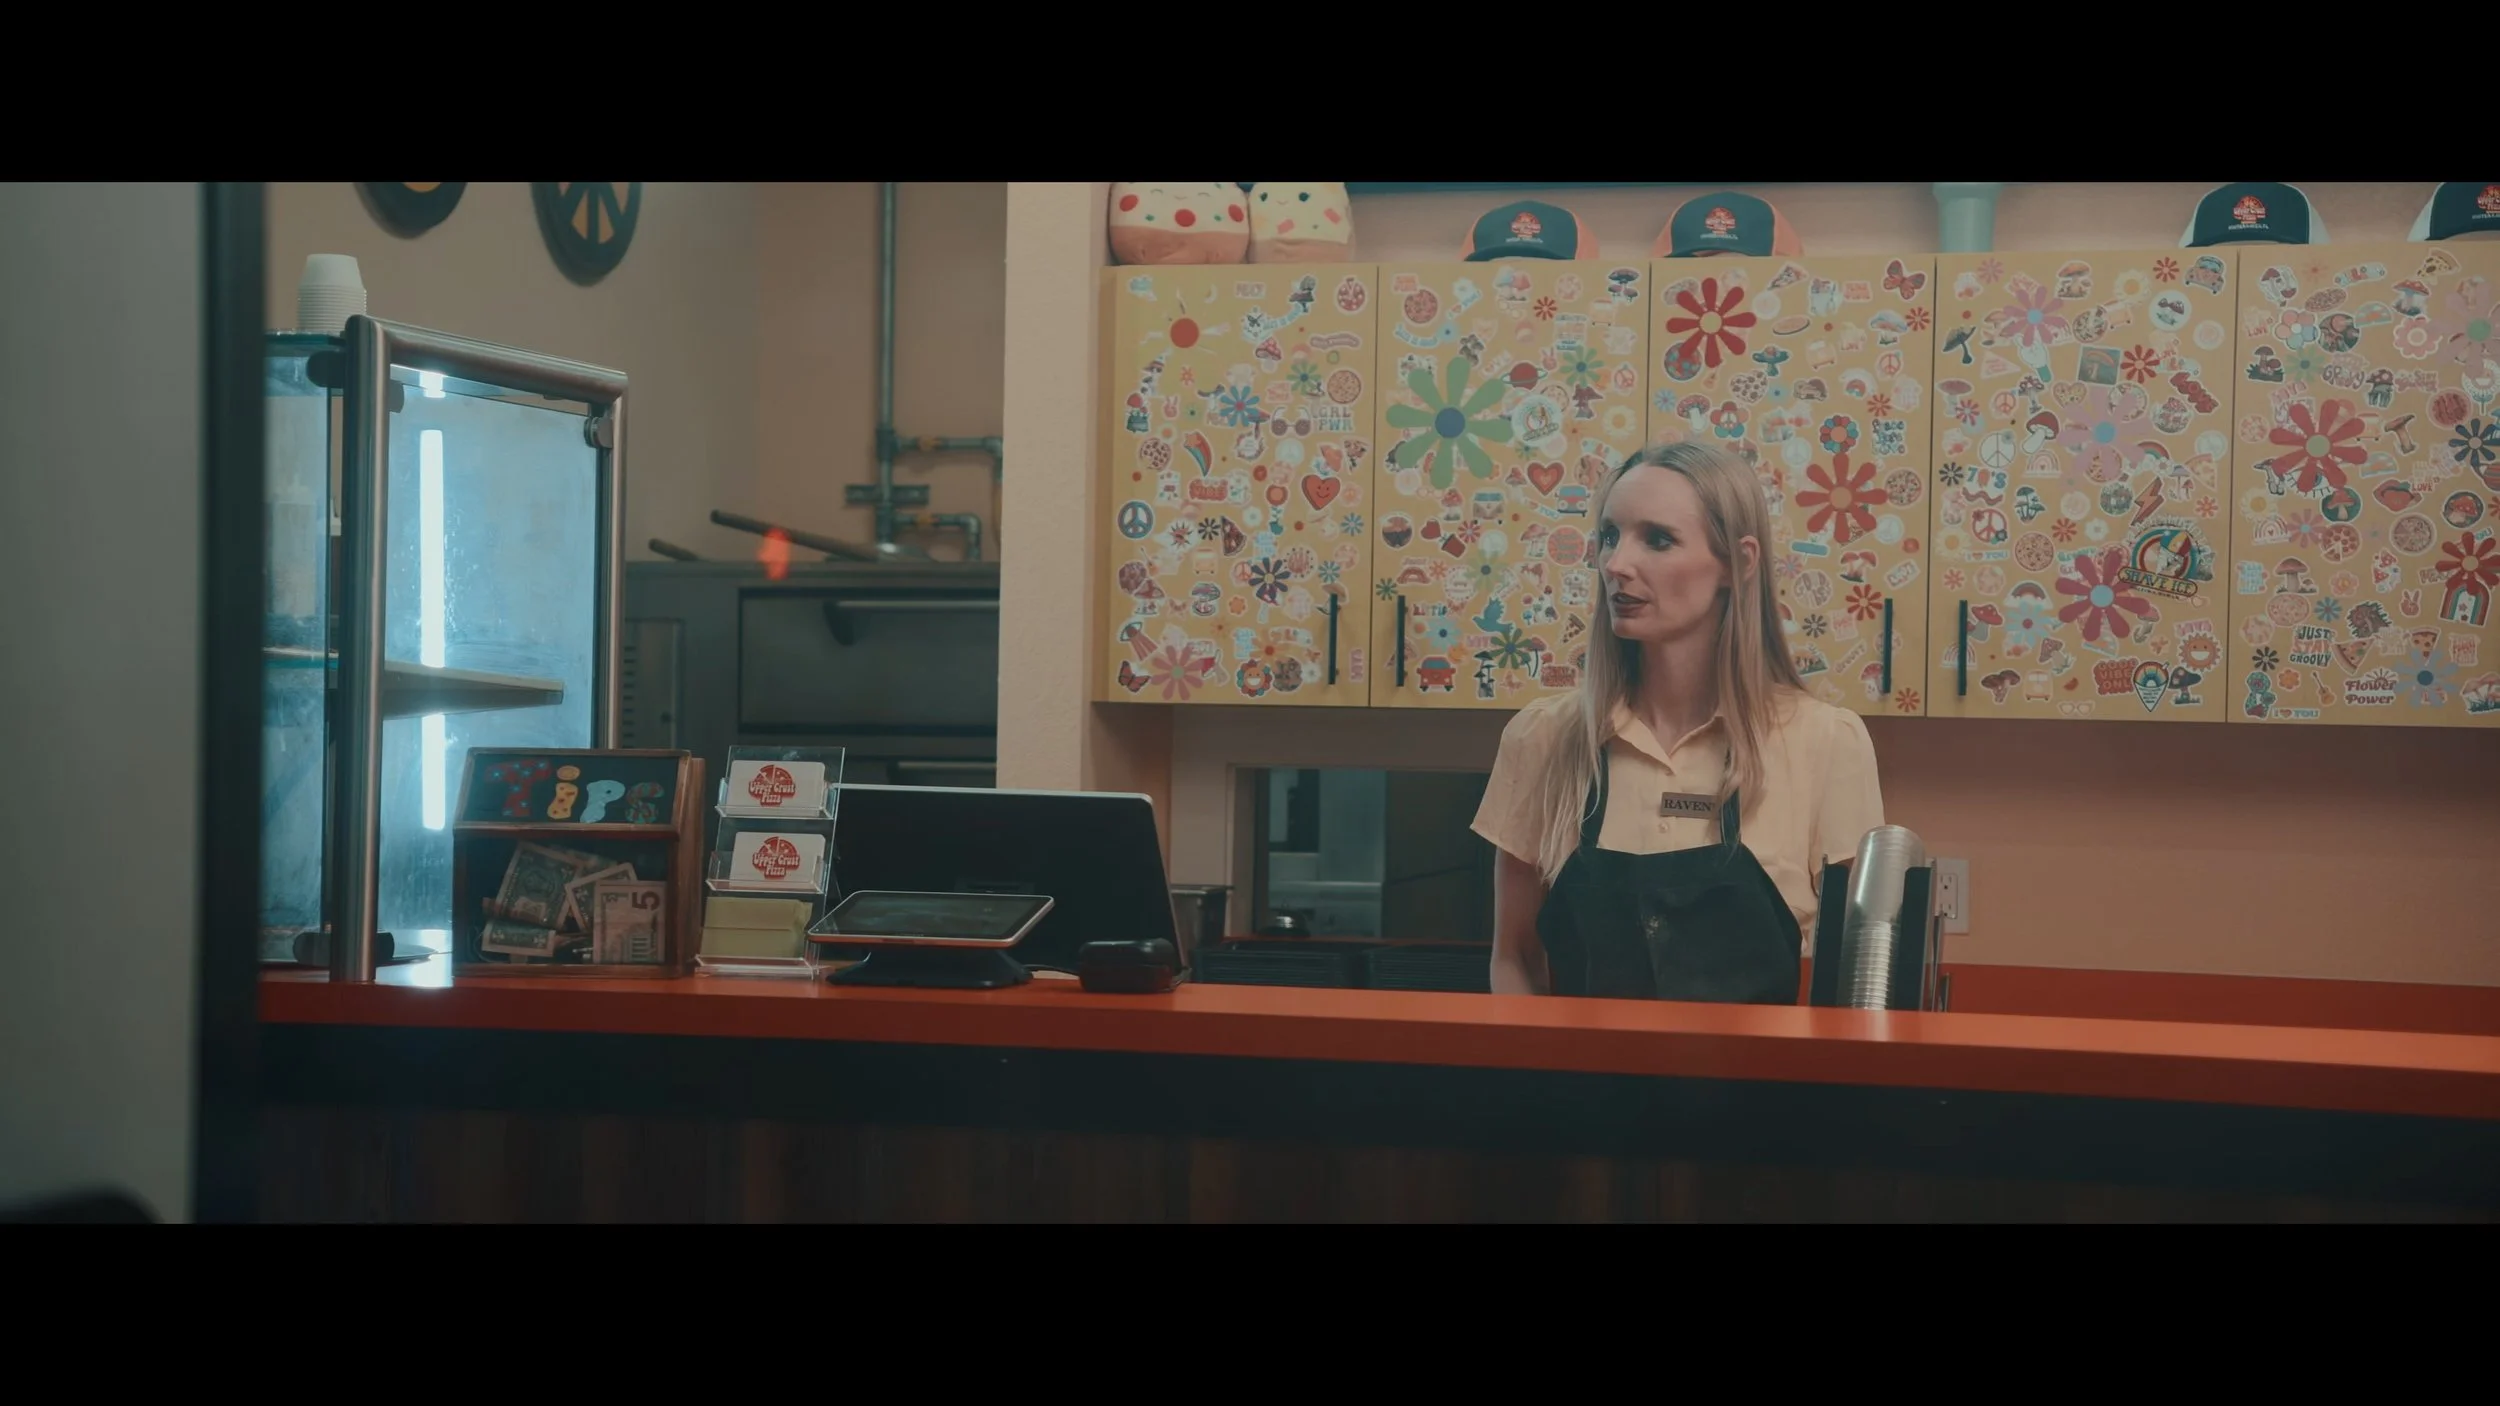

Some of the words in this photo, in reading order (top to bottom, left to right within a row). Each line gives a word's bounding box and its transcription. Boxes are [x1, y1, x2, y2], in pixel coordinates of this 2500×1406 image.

[2124, 569, 2167, 589] SHAVE
[2298, 626, 2331, 640] JUST
[2345, 679, 2397, 691] Flower
[2345, 694, 2394, 704] Power
[748, 781, 773, 794] Upper
[773, 782, 796, 793] Crust
[761, 792, 782, 803] Pizza
[1664, 800, 1715, 811] RAVEN
[752, 853, 777, 866] Upper
[777, 854, 800, 866] Crust
[765, 865, 786, 876] Pizza
[632, 890, 660, 911] 5
